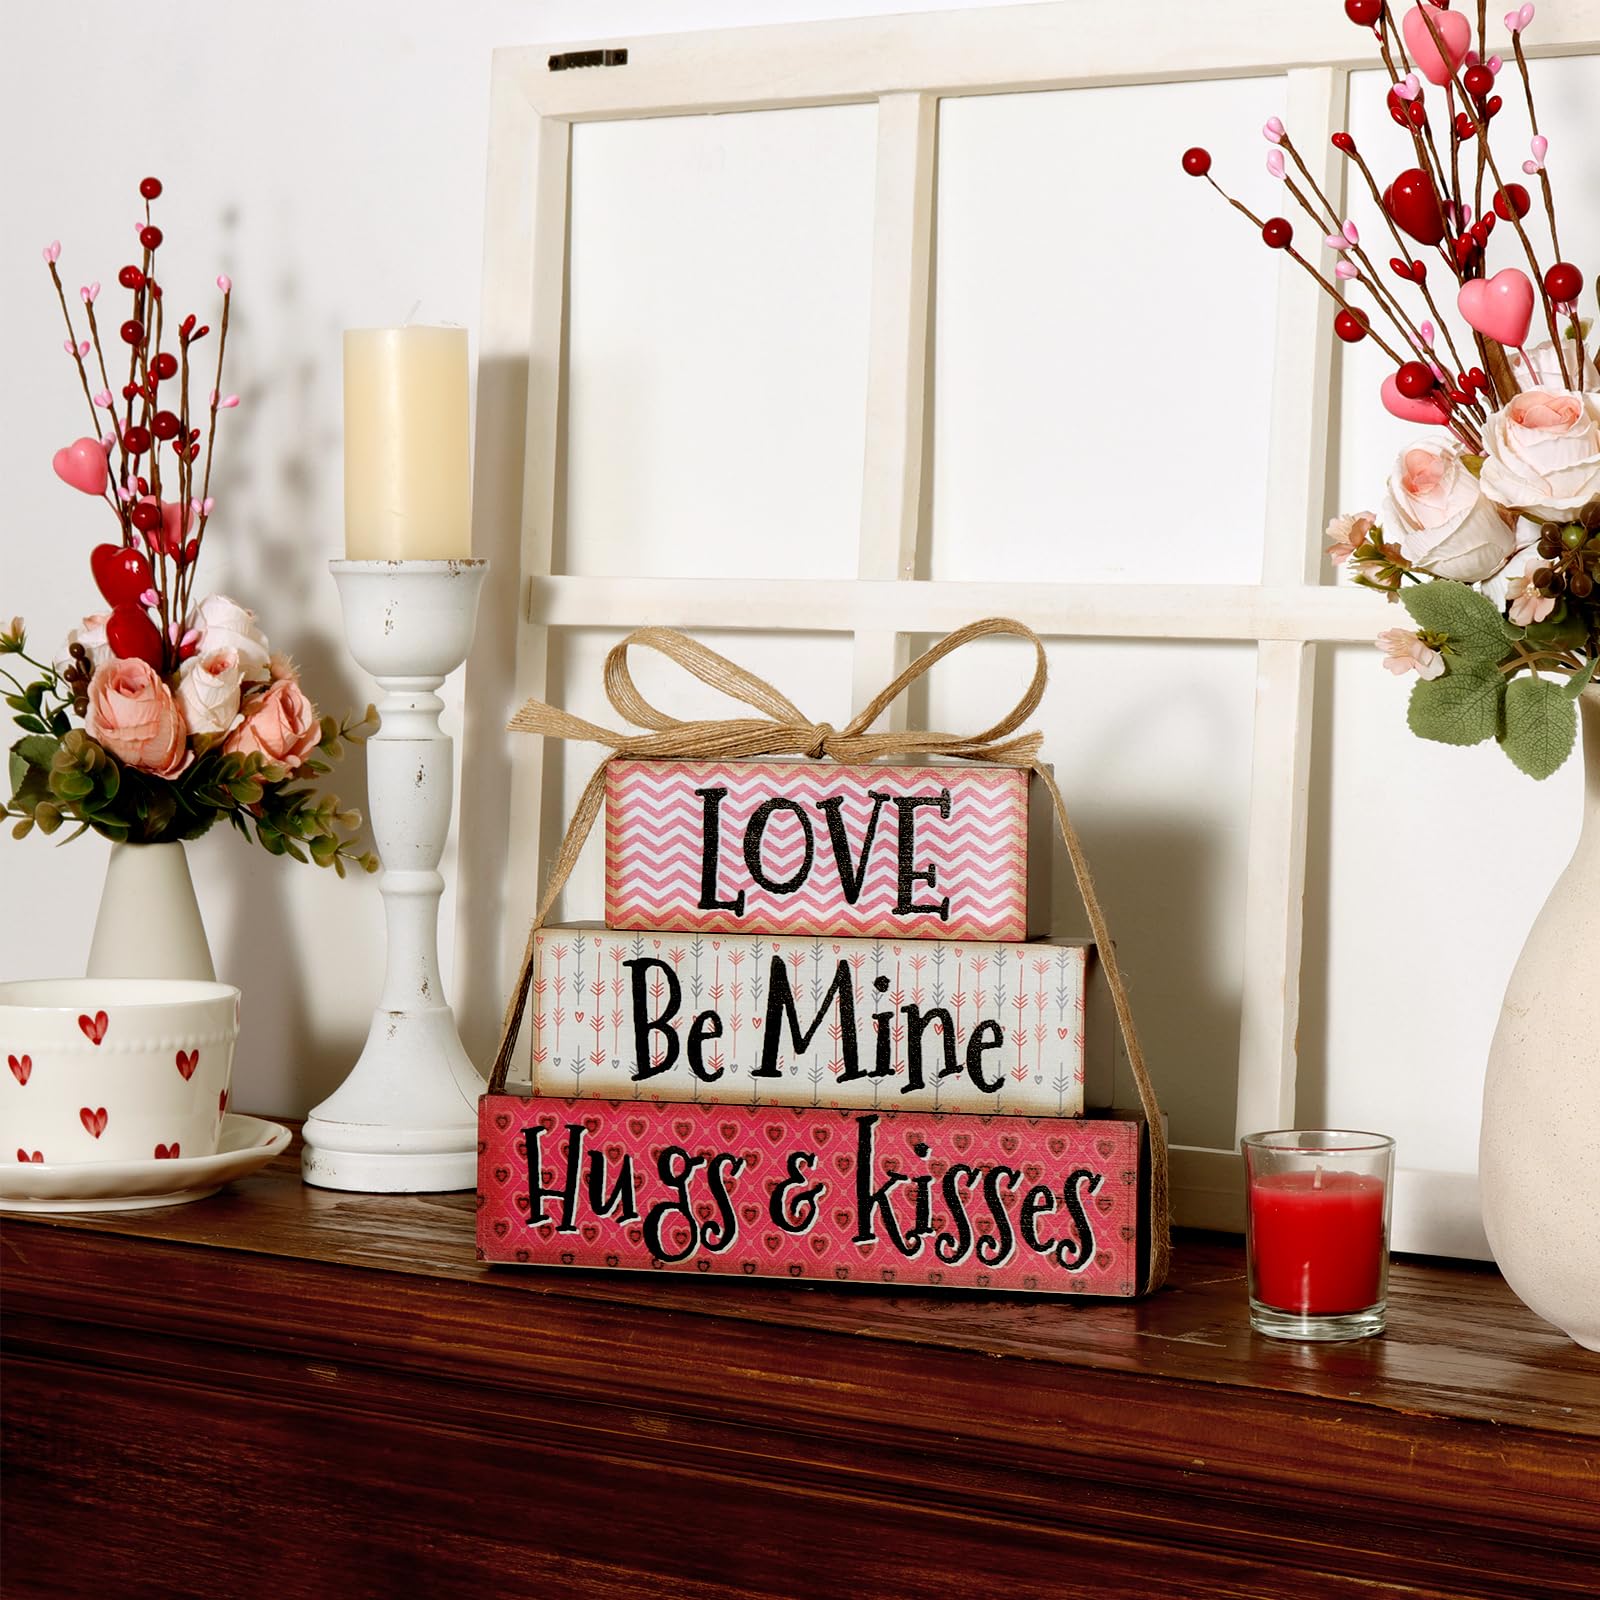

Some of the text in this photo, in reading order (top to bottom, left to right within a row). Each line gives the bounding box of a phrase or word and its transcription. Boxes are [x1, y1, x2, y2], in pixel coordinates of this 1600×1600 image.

[695, 788, 950, 921] LOVE
[623, 956, 1005, 1094] Be Mine
[519, 1114, 1103, 1272] Hugs & kisses
